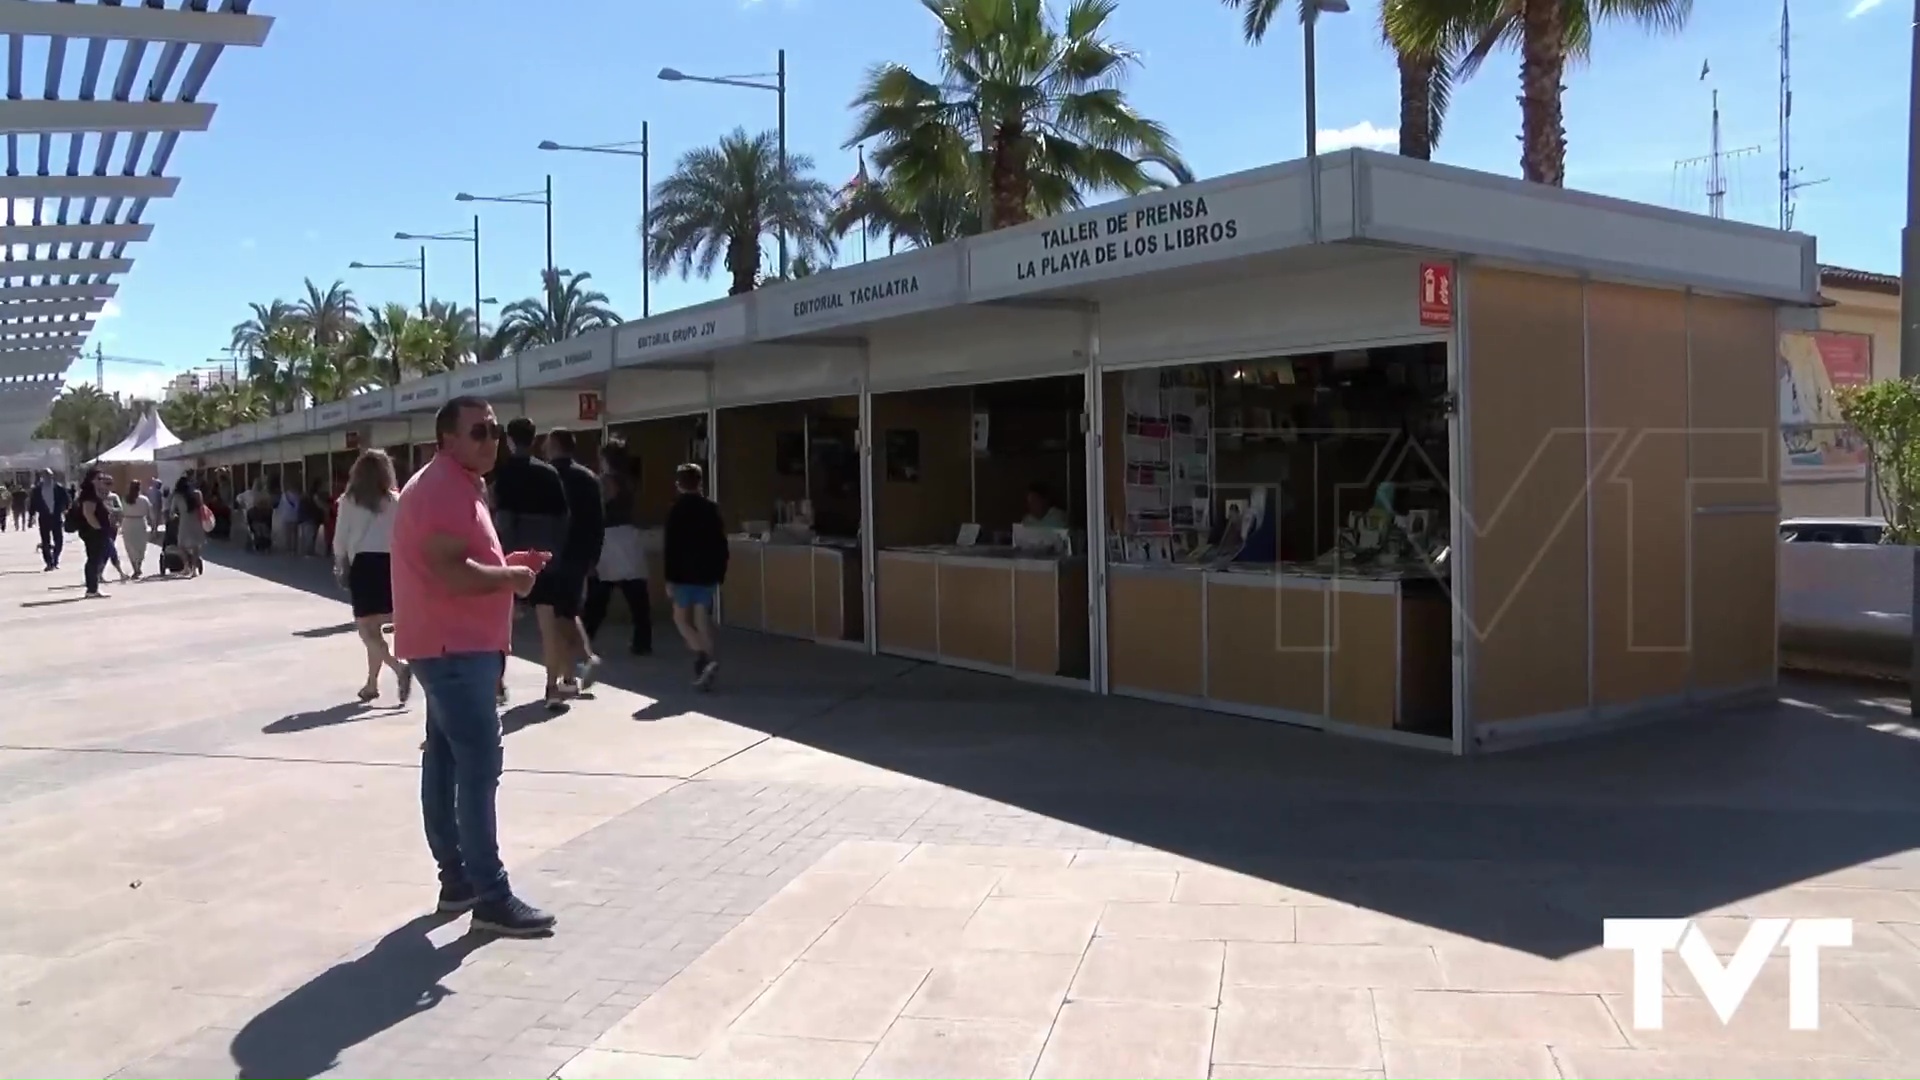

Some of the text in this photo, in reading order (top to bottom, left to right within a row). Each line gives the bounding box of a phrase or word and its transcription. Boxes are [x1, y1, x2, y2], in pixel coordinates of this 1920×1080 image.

[1041, 197, 1208, 249] TALLER DE PRENSA
[1017, 219, 1237, 280] LA PLAYA DE LOS LIBROS
[793, 276, 919, 317] EDITORIAL TACALATRA
[672, 325, 698, 342] GRUPO
